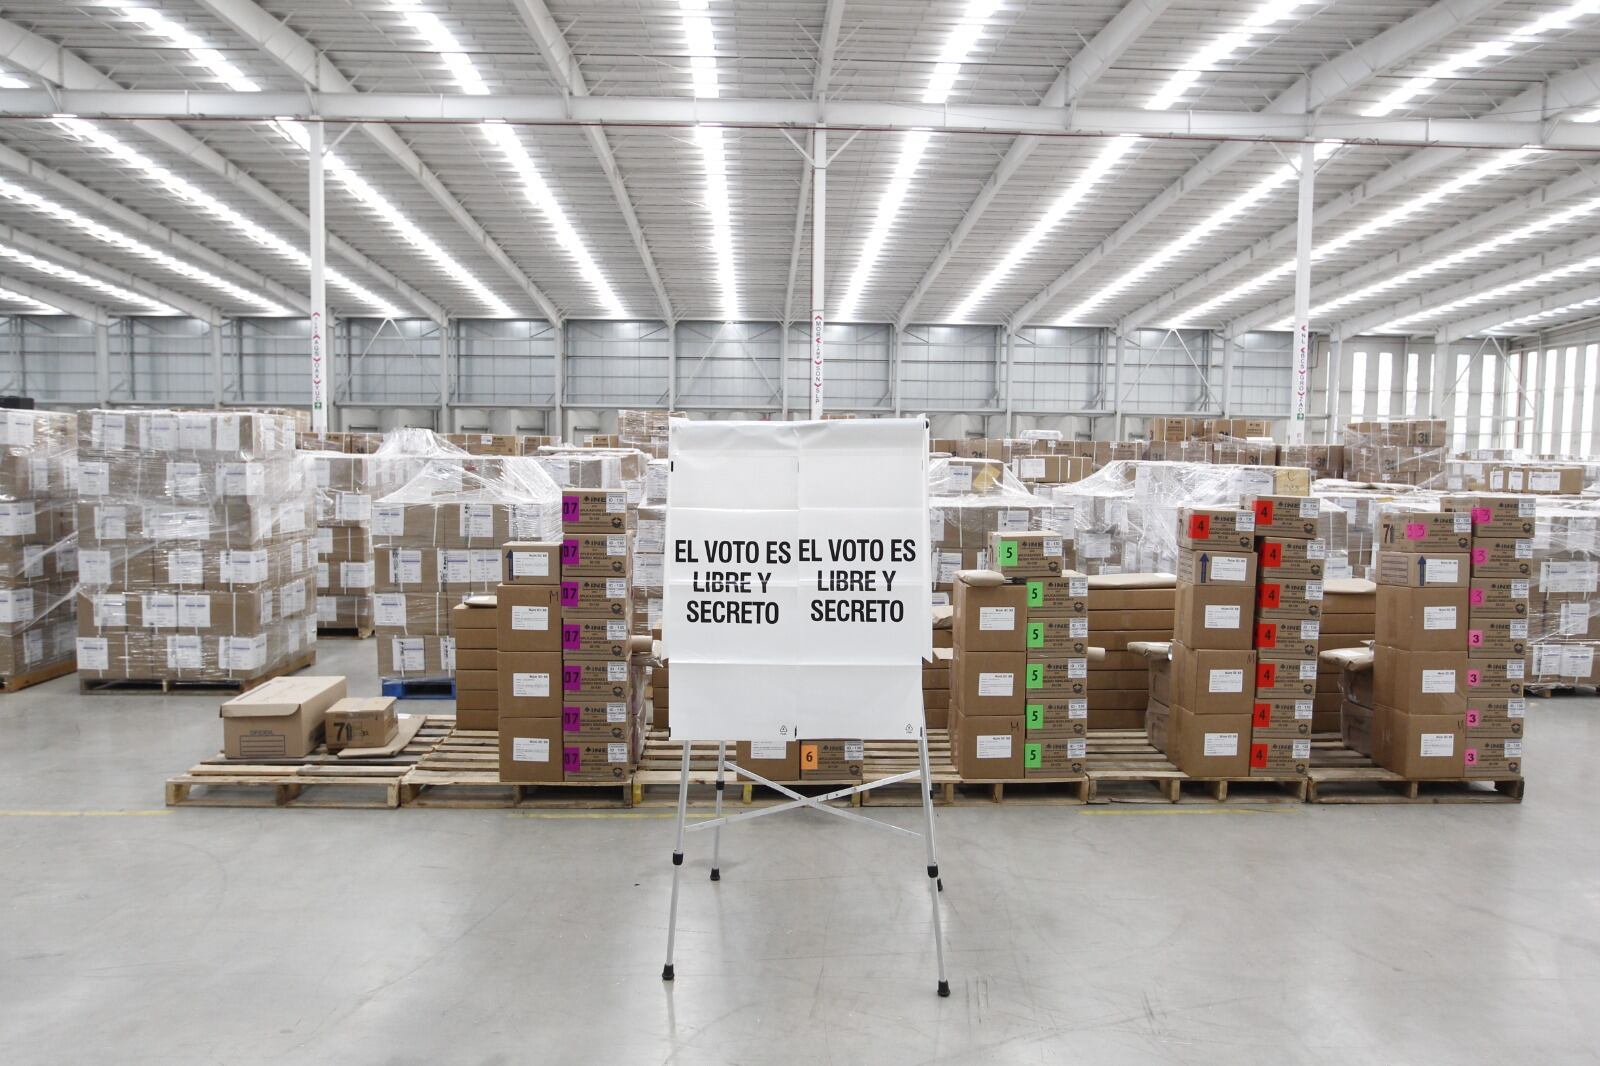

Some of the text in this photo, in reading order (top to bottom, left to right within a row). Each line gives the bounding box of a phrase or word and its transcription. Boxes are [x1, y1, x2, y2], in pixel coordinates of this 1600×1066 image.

[562, 503, 577, 514] 07
[1261, 506, 1267, 518] 4
[1199, 520, 1204, 531] 4
[1383, 524, 1391, 544] 7
[563, 546, 577, 557] 07
[676, 540, 791, 564] EL VOTO ES
[799, 539, 915, 561] EL VOTO ES
[1006, 547, 1012, 558] 5
[1270, 549, 1276, 560] 4
[694, 572, 771, 593] LIBRE Y
[818, 571, 896, 591] LIBRE Y
[563, 588, 577, 599] 07
[1032, 588, 1037, 599] 5
[1268, 590, 1274, 600] 4
[687, 601, 778, 624] SECRETO
[811, 600, 903, 622] SECRETO
[565, 631, 578, 642] 07
[1033, 629, 1038, 640] 5
[1265, 630, 1271, 640] 4
[1473, 635, 1479, 643] 3
[564, 672, 579, 683] 07
[1032, 670, 1038, 681] 5
[1264, 670, 1270, 680] 4
[1470, 674, 1477, 683] 3
[1032, 711, 1038, 721] 5
[1259, 710, 1265, 720] 4
[1469, 714, 1476, 722] 3
[334, 722, 345, 741] 7
[806, 751, 813, 762] 6
[1030, 750, 1036, 760] 5
[1256, 749, 1262, 761] 4
